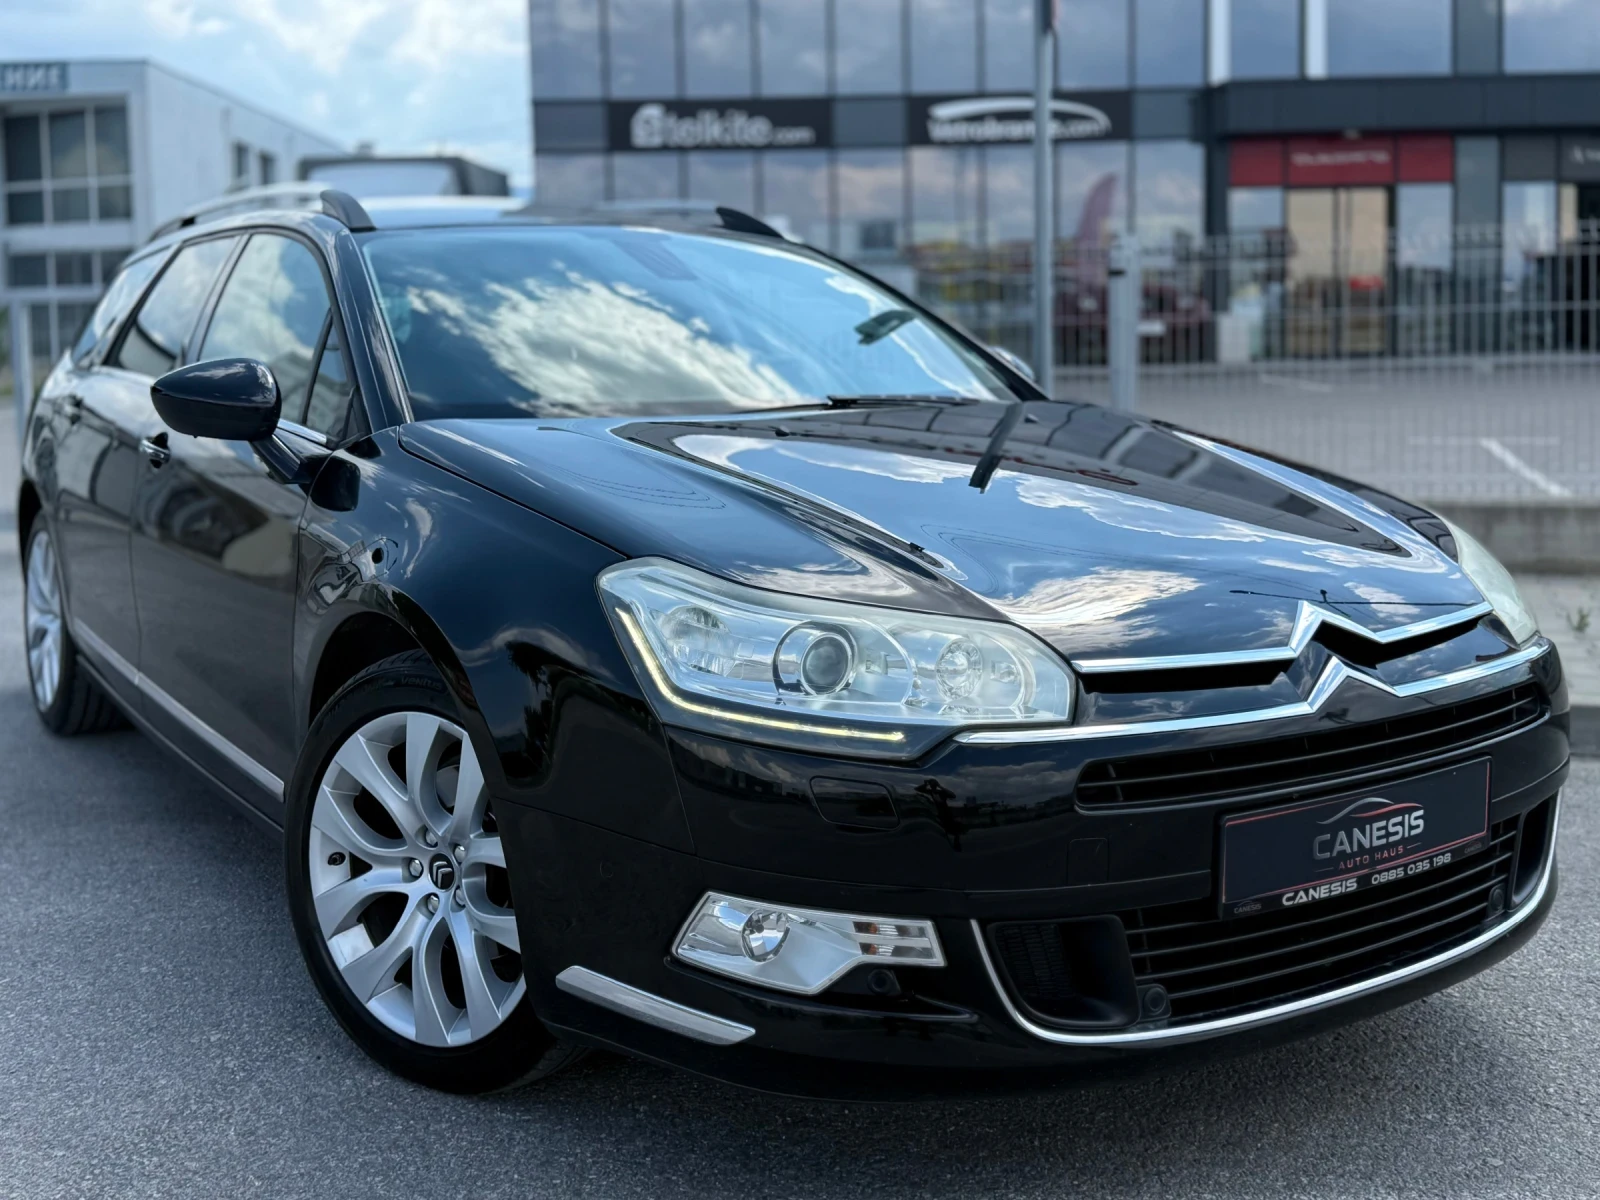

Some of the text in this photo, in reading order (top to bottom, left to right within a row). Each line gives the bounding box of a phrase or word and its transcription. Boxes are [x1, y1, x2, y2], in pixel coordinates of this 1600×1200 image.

[0, 65, 60, 89] НИЕ
[1313, 809, 1425, 860] CANESIS
[1339, 845, 1404, 870] AUTO HAUS
[1282, 852, 1452, 906] CANESIS 0885 035 198
